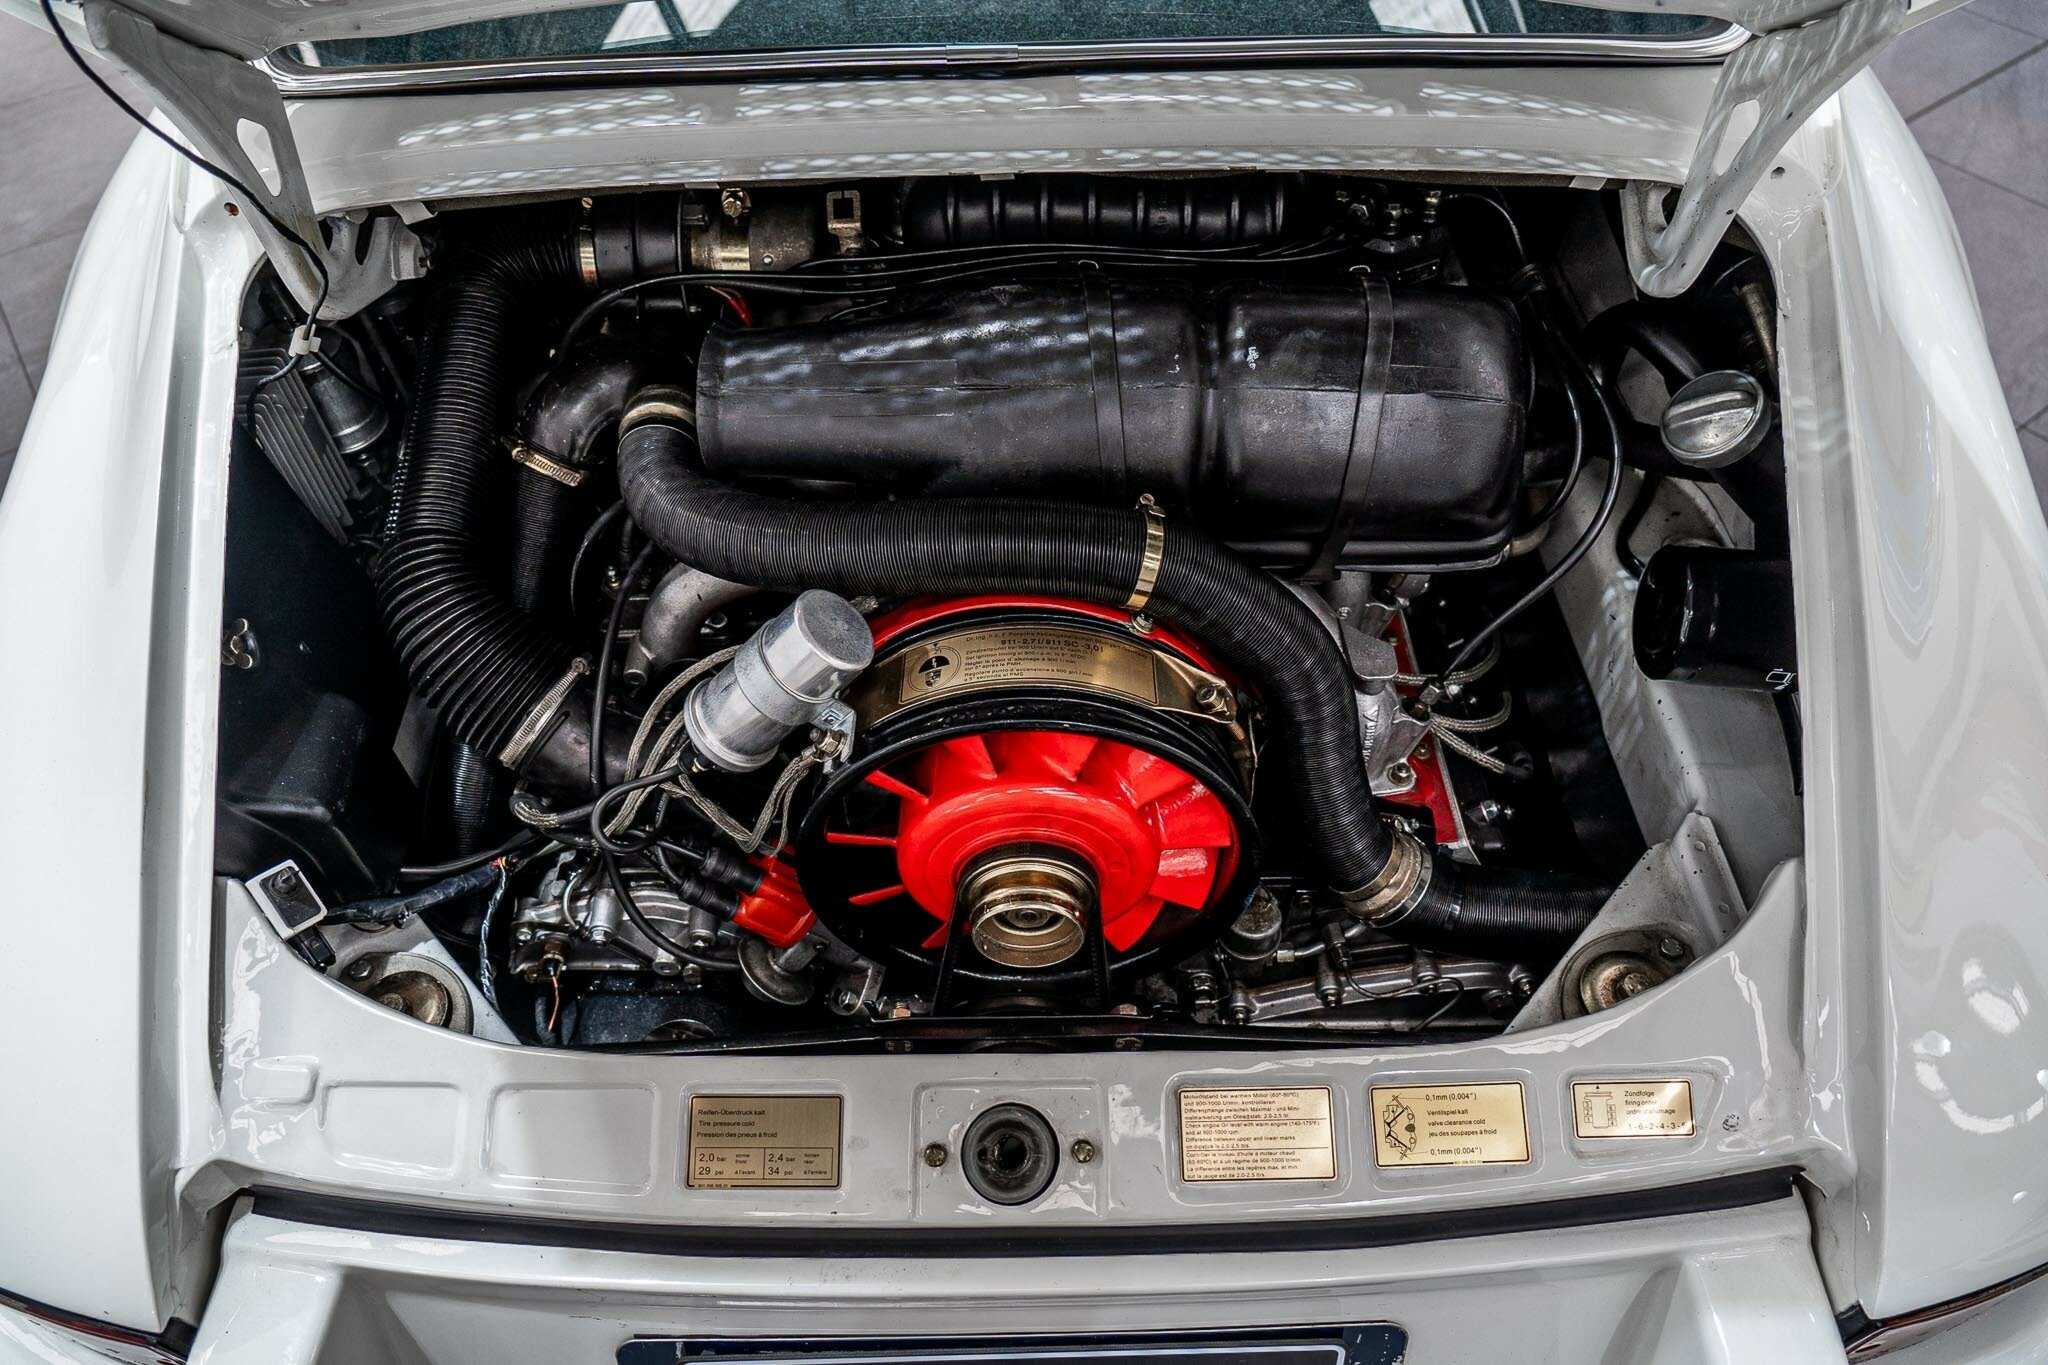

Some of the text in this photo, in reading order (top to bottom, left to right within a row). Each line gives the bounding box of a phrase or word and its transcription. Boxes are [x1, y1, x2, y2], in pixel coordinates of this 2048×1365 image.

[1624, 1090, 1655, 1098] Zündfolge
[1624, 1099, 1641, 1107] firing
[698, 1108, 754, 1116] Reifen-Überdruck
[713, 1120, 741, 1128] pressure
[699, 1153, 715, 1163] 2,0
[768, 1153, 783, 1163] 2,4
